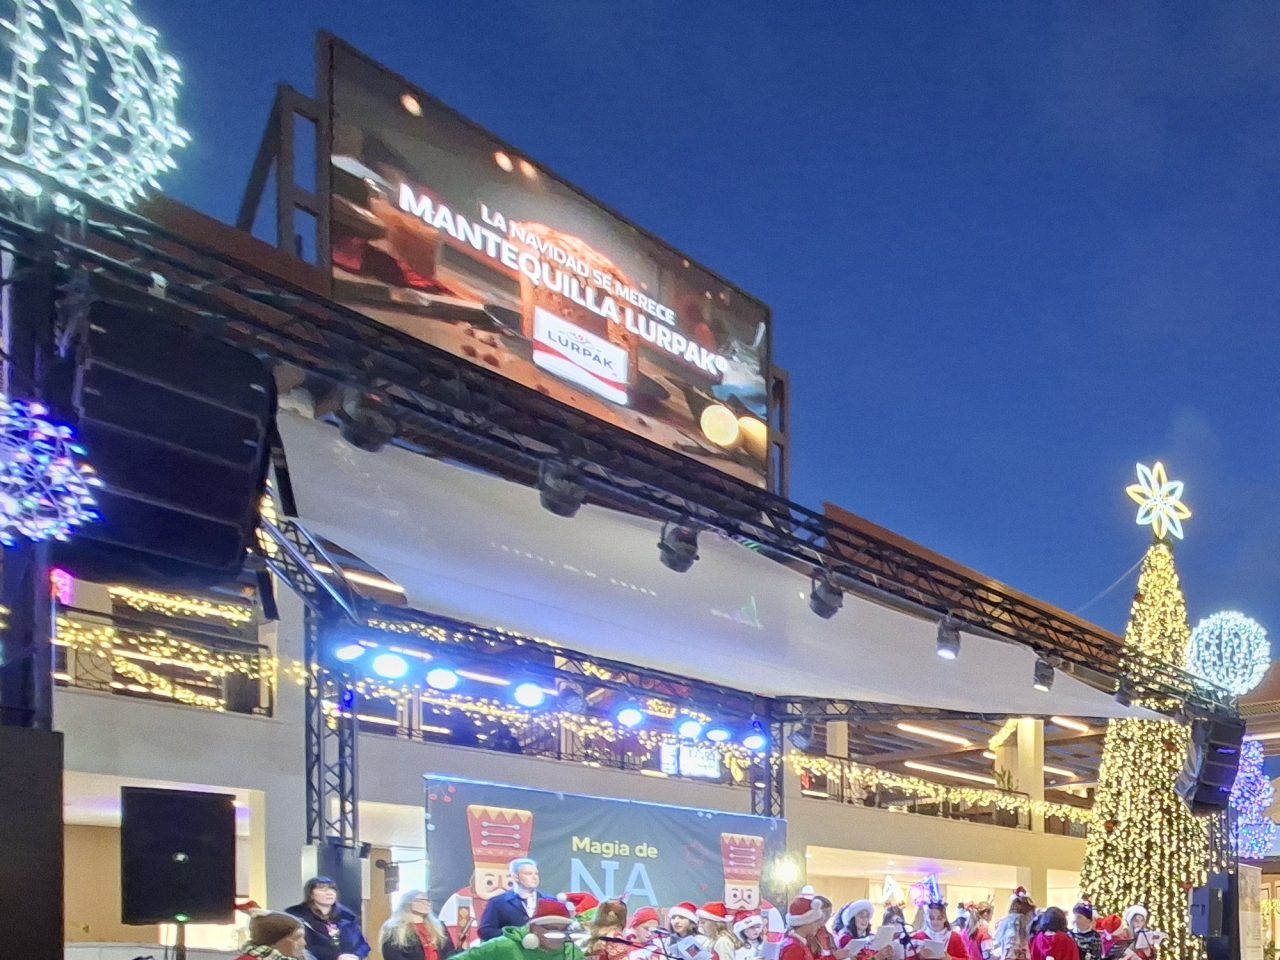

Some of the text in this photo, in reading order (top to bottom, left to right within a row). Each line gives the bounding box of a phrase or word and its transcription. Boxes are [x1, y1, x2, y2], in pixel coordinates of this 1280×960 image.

[399, 182, 621, 325] MANTEQUILLA
[480, 203, 676, 326] LA NAVIDAD SE MERECE
[547, 330, 614, 370] LURPAK
[571, 836, 658, 858] Magia de
